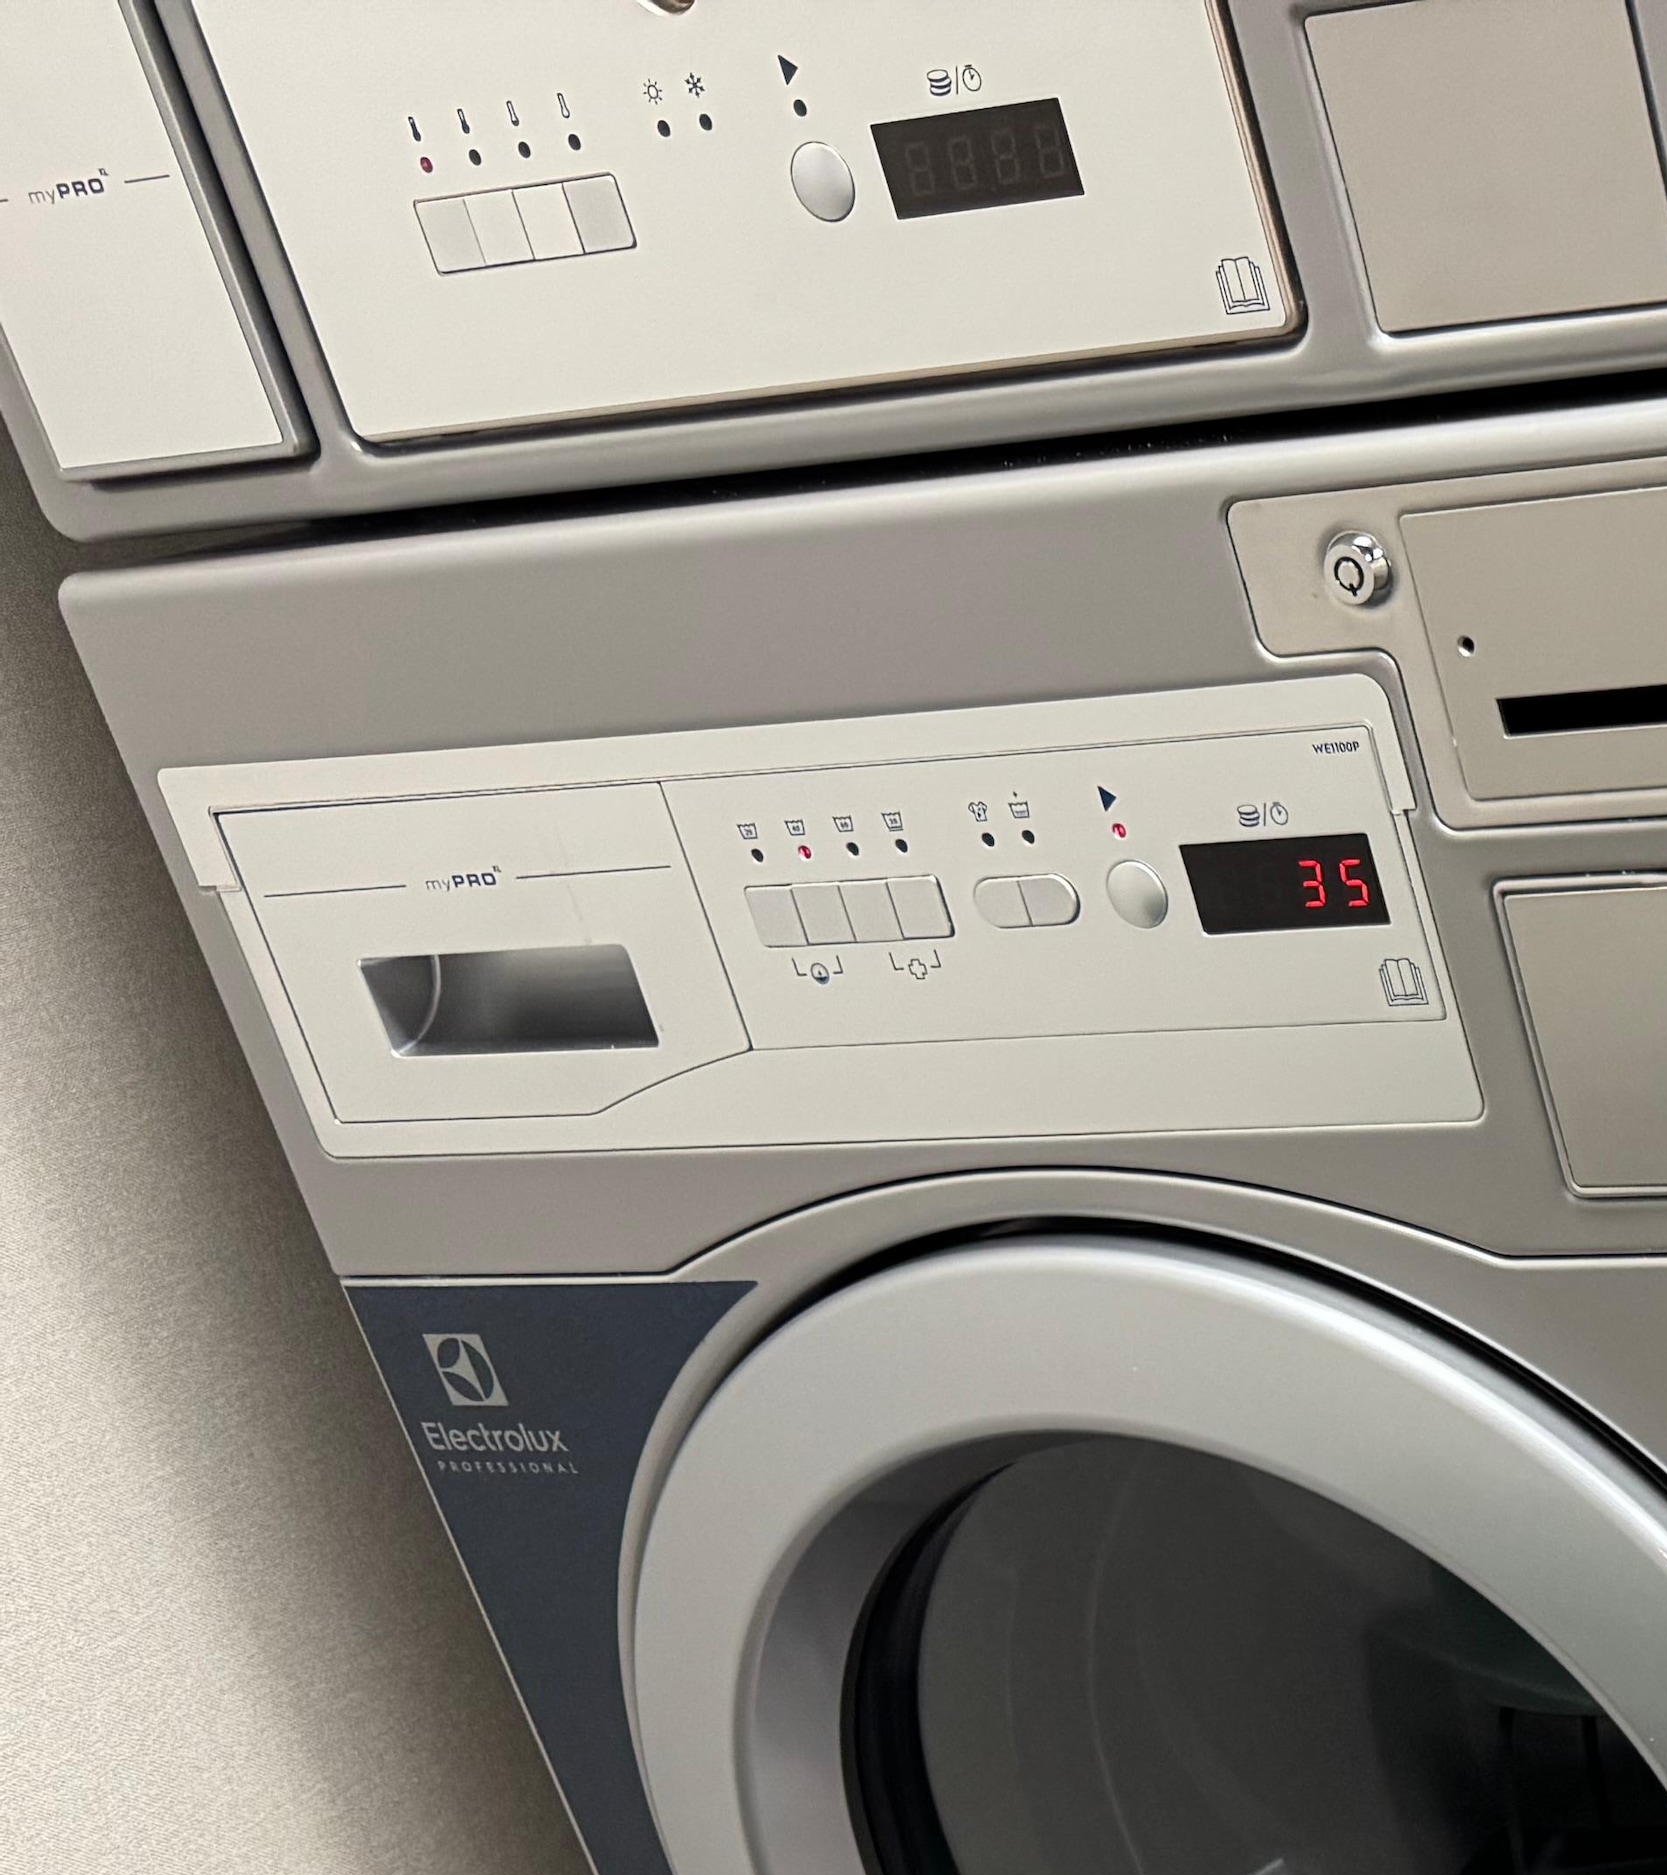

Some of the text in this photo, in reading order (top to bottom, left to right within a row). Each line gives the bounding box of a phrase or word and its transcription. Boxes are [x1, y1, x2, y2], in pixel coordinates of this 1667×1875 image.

[1298, 858, 1369, 908] 35
[421, 1421, 569, 1452] Electrolux
[437, 1460, 579, 1474] PROFESSIONAL
